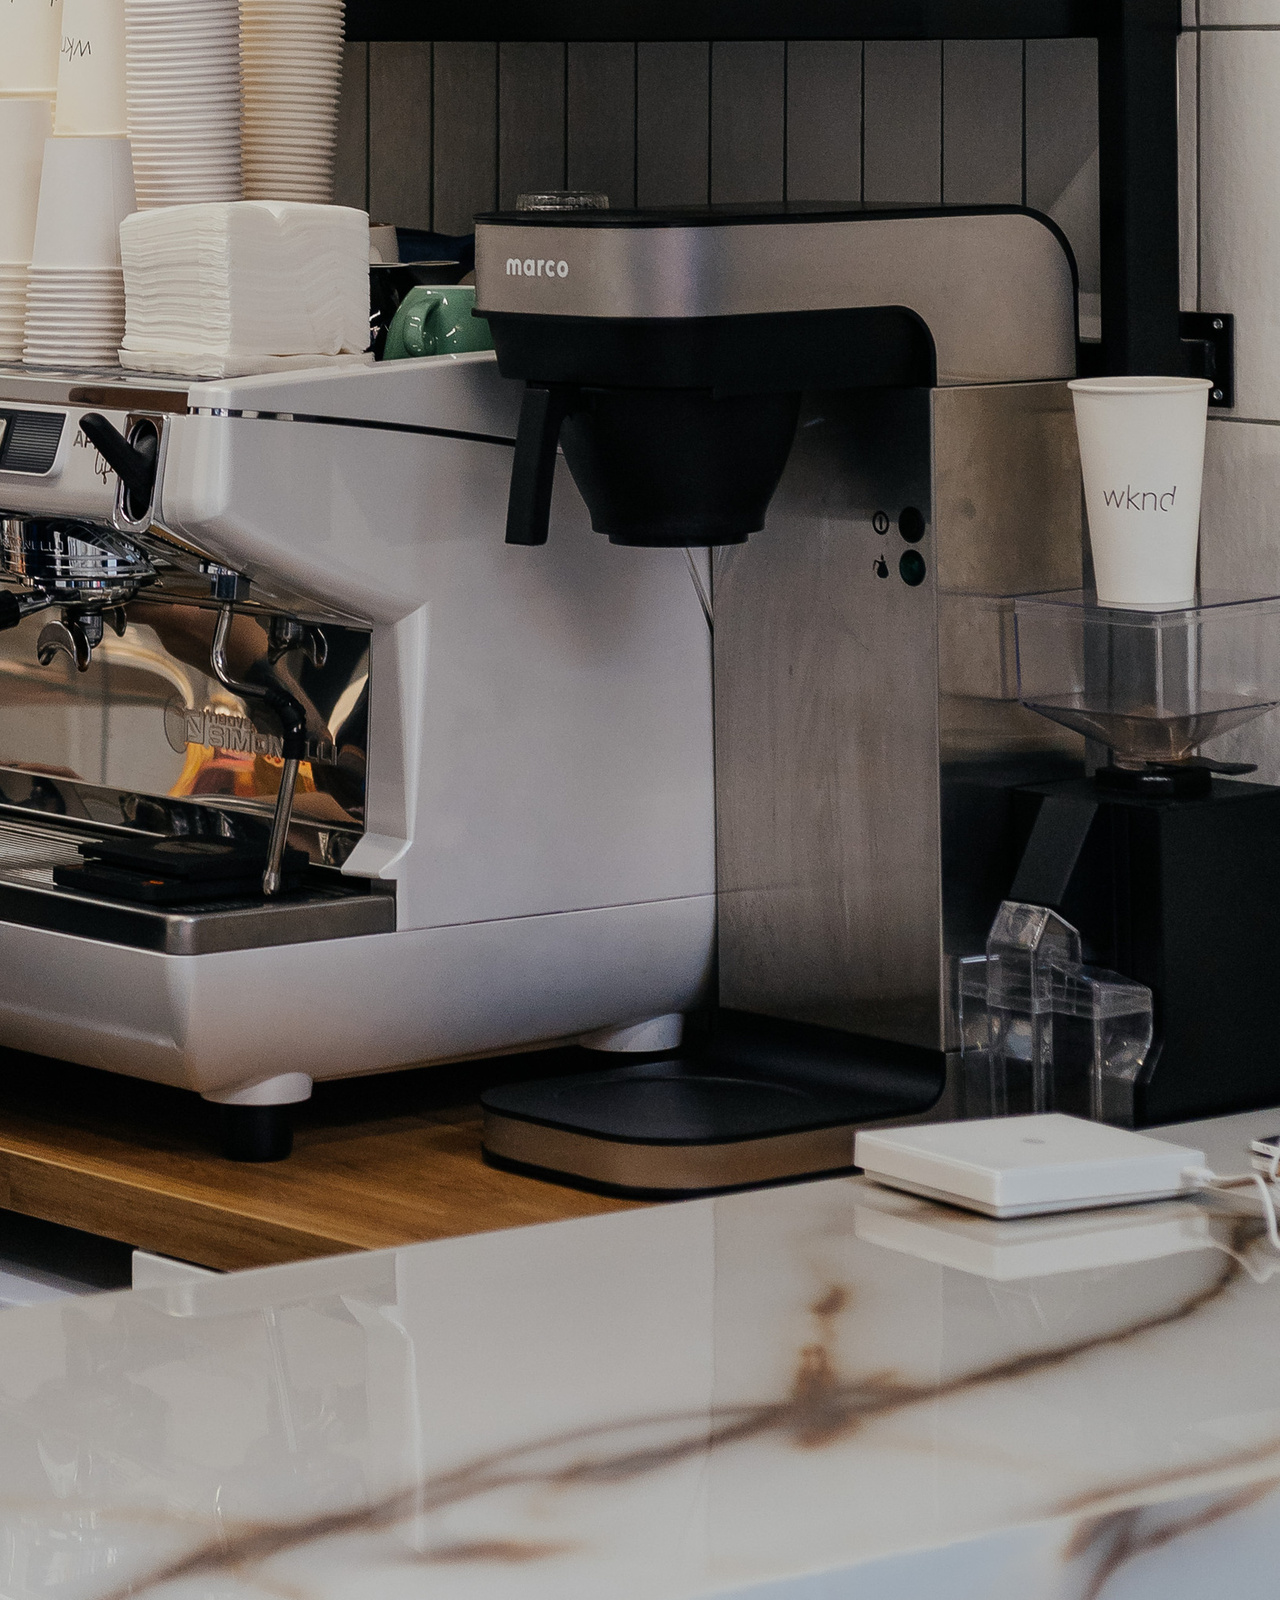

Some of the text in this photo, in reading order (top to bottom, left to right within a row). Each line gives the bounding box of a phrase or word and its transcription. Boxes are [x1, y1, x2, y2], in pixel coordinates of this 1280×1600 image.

[506, 258, 569, 278] marco
[1103, 484, 1176, 512] wknd
[209, 725, 338, 766] SIMONLLI
